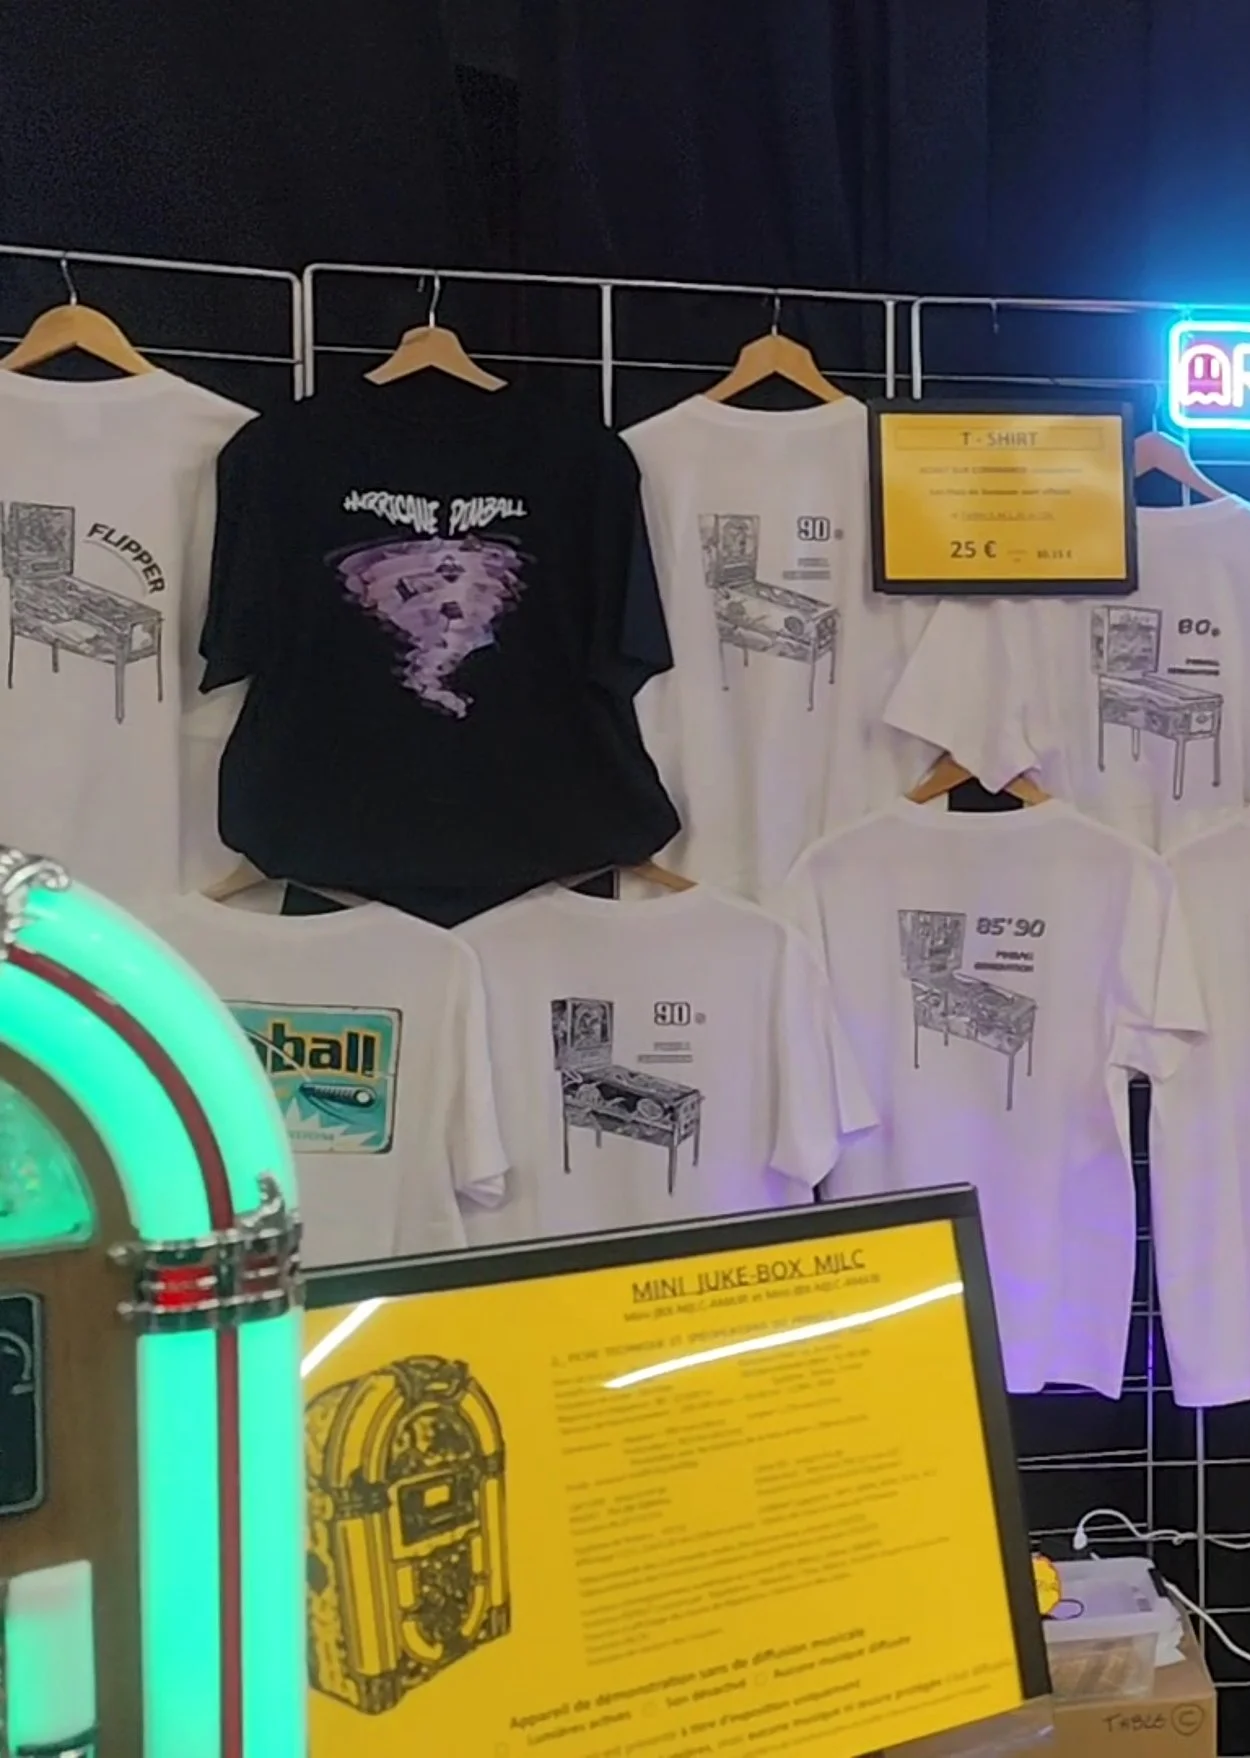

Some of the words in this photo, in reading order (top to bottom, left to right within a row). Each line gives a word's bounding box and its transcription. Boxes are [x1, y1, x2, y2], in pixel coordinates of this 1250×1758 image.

[449, 496, 527, 536] PINBALL
[87, 522, 166, 594] FLIPPER
[949, 541, 977, 559] 25
[984, 540, 997, 559] €
[252, 1022, 376, 1078] ball
[632, 1275, 686, 1303] MINI
[696, 1257, 804, 1296] JUKE-BOX
[813, 1249, 867, 1275] MJLC
